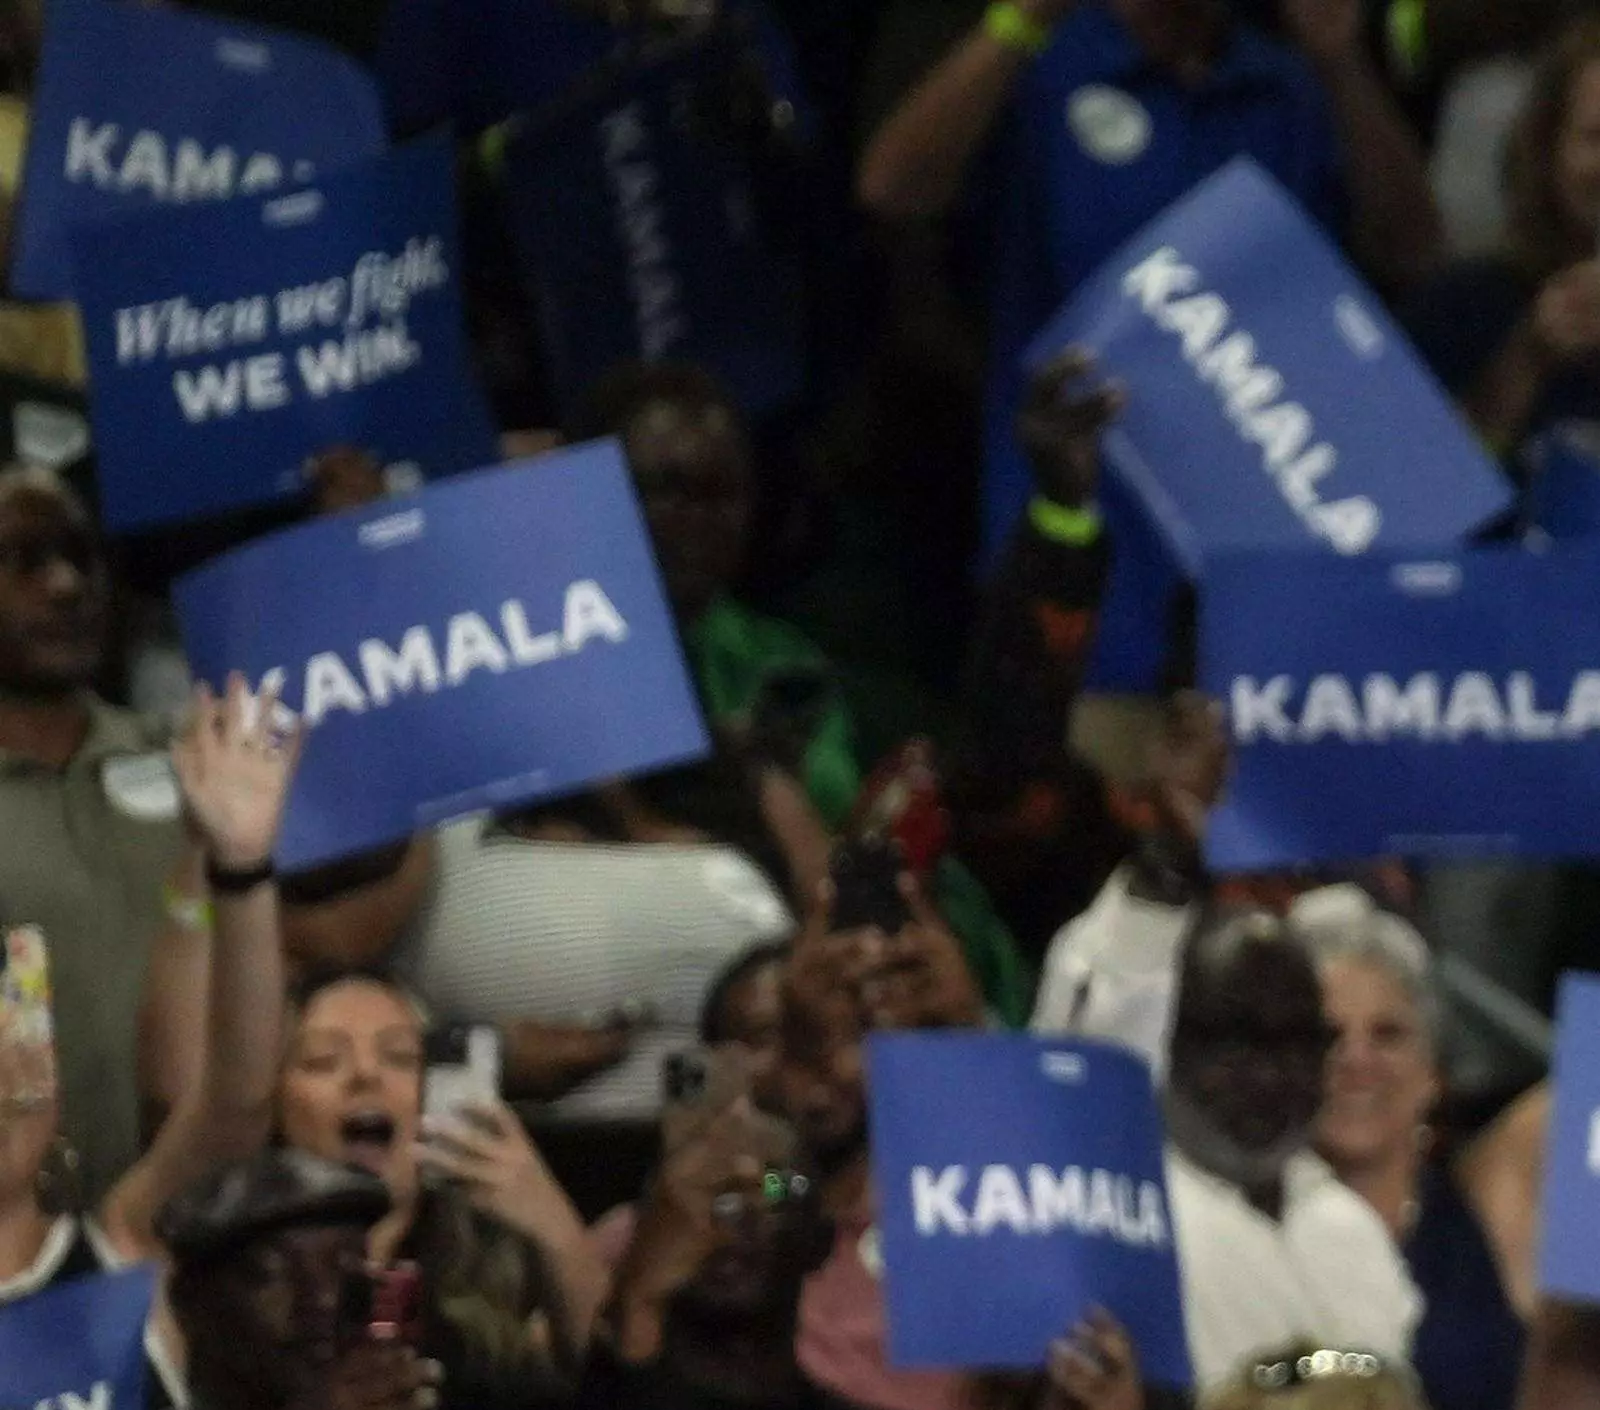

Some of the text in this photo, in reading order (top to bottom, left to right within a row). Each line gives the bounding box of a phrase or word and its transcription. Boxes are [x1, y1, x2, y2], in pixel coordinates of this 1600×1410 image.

[64, 115, 317, 203] KAMA
[115, 295, 269, 366] When
[273, 275, 347, 335] we
[172, 350, 292, 424] WE
[1120, 245, 1382, 556] KAMALA
[238, 578, 628, 735] KAMALA
[910, 1163, 1170, 1249] KAMALA
